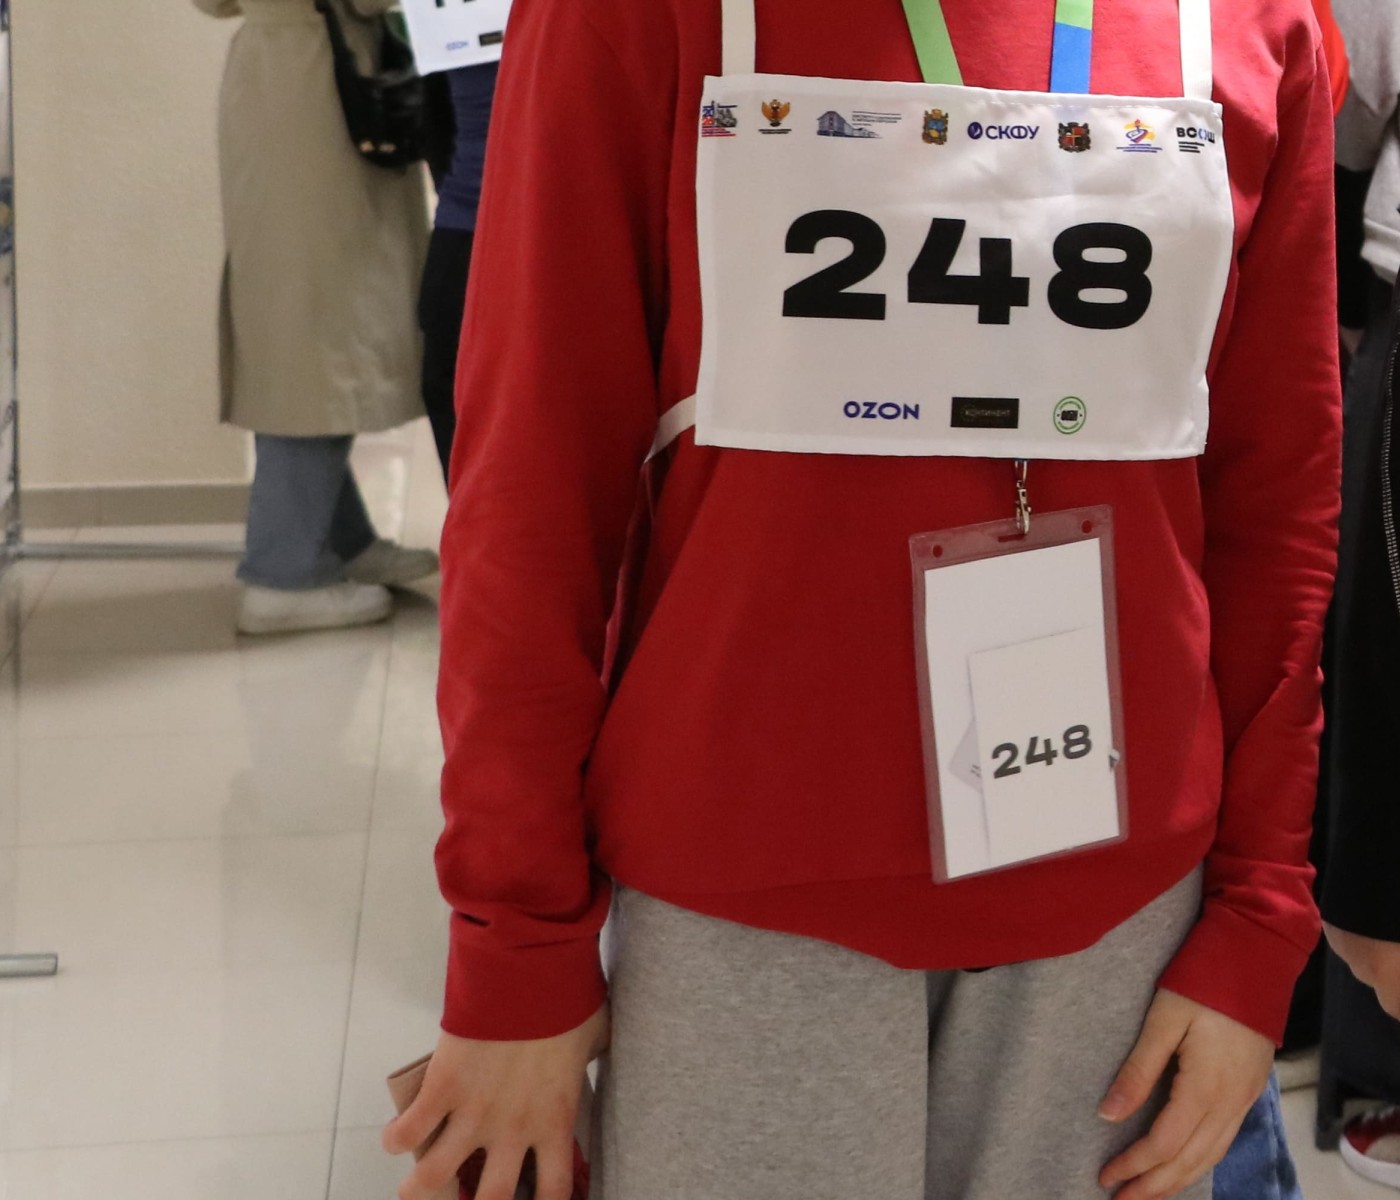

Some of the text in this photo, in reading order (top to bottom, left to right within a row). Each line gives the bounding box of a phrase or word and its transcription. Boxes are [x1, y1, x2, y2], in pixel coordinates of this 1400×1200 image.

[986, 124, 1040, 140] СКФУ
[783, 210, 1152, 330] 248
[843, 400, 920, 420] OZON
[991, 724, 1092, 779] 248
